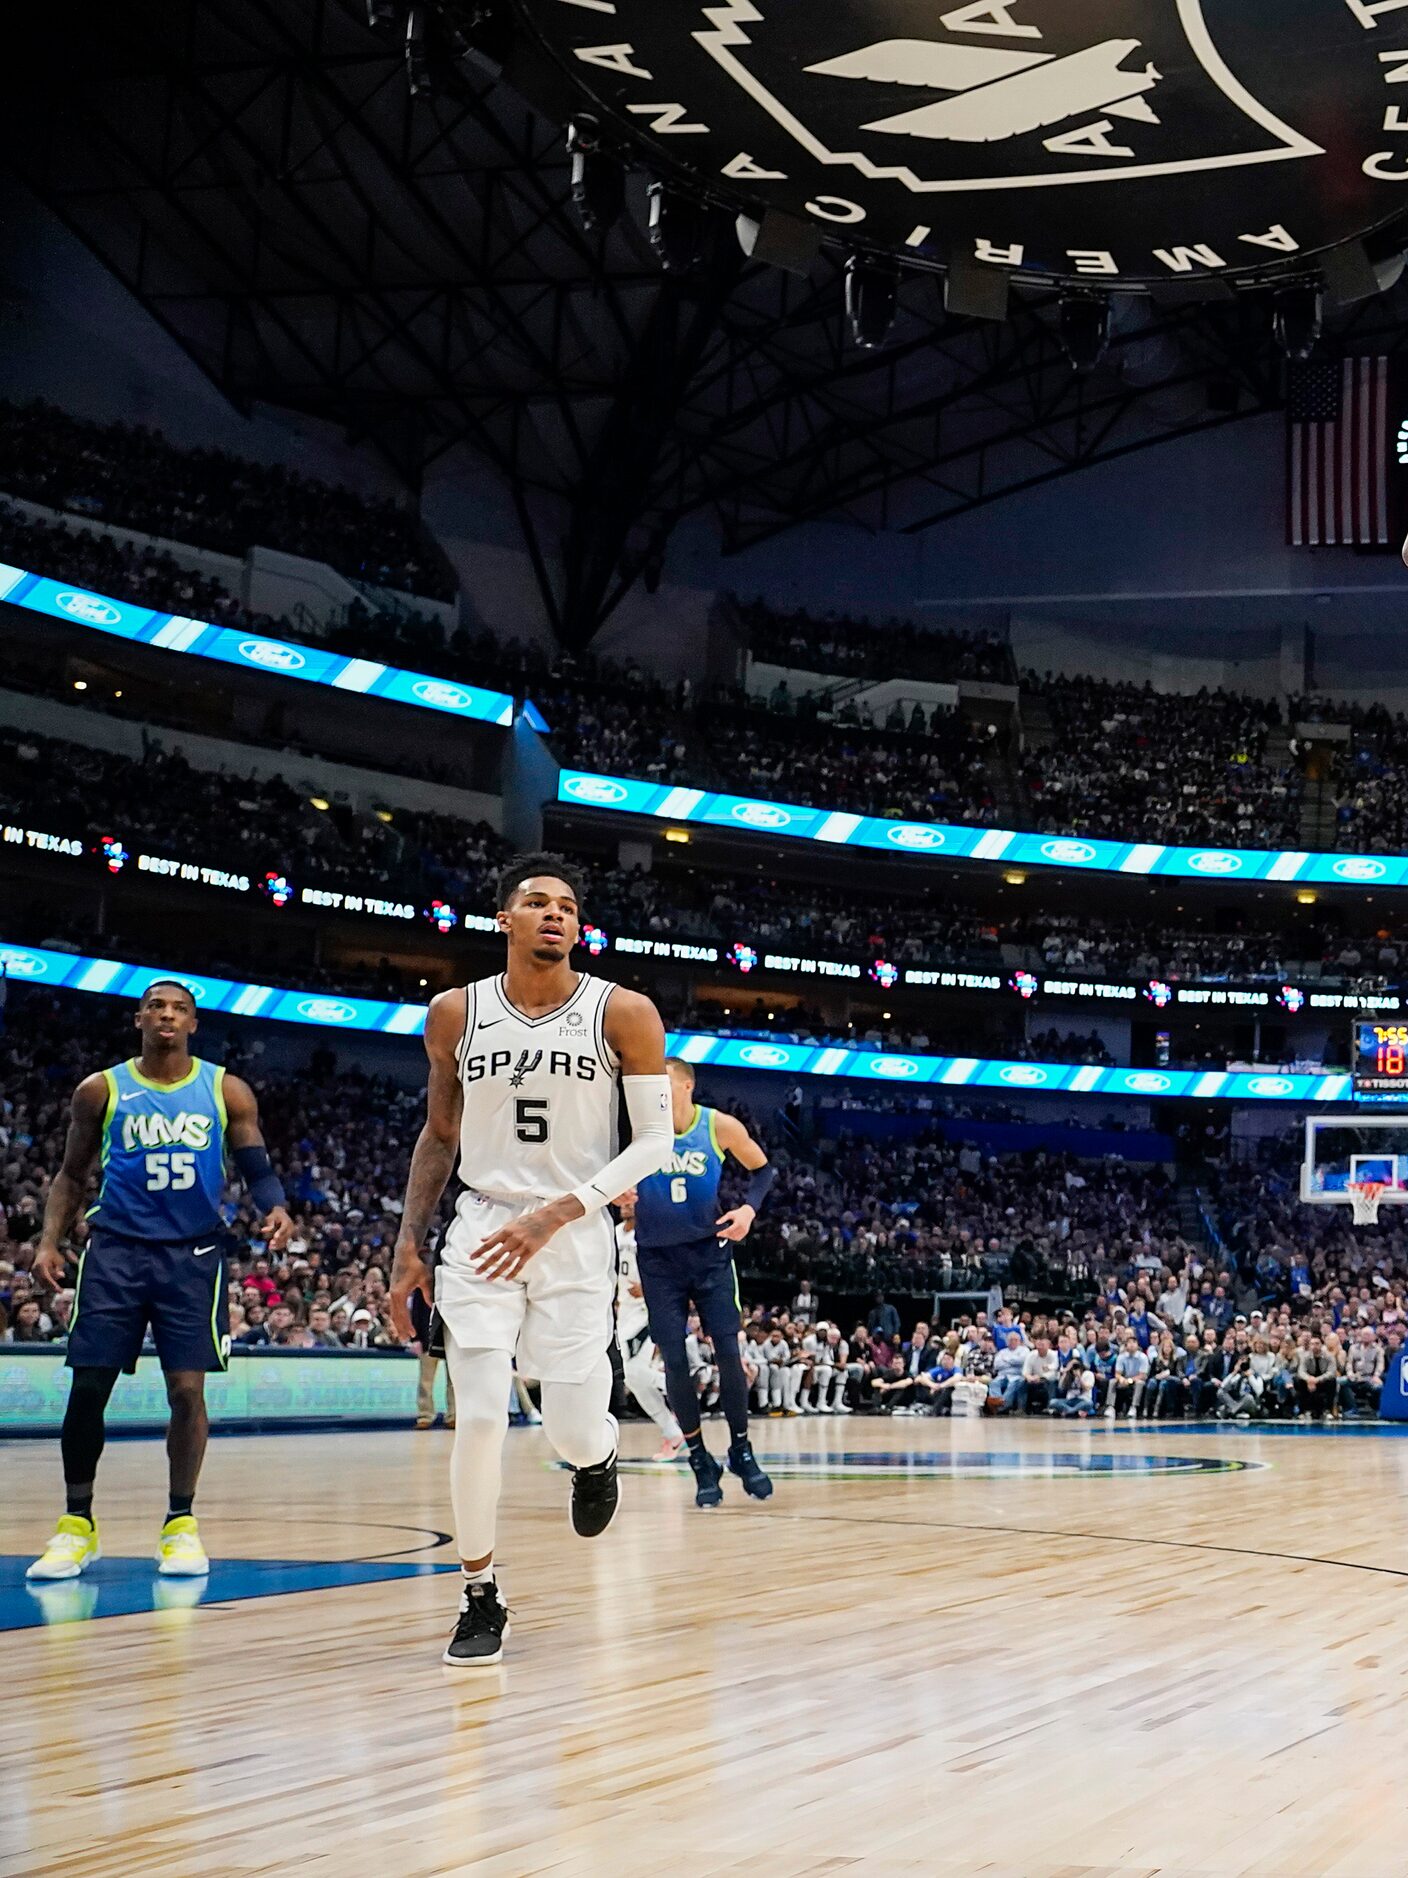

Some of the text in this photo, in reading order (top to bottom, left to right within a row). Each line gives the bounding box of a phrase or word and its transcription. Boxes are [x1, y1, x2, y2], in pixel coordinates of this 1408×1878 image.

[5, 827, 82, 855] IN TEXAS
[139, 855, 249, 890] BEST IN TEXAS
[302, 889, 414, 918] BEST IN TEXAS
[616, 938, 717, 961] BEST IN TEXAS
[765, 955, 860, 977] BEST IN TEXAS
[906, 971, 1000, 988] BEST IN TEXAS
[1044, 981, 1136, 998] BEST IN TEXAS
[1178, 990, 1268, 1004] BEST IN TEXAS
[1311, 995, 1342, 1007] BEST
[1344, 996, 1358, 1007] IN
[558, 1026, 588, 1037] Frost
[1373, 1026, 1408, 1046] 7:55
[467, 1049, 596, 1089] SPURS
[1376, 1045, 1404, 1074] 18
[123, 1111, 213, 1151] MAVS
[514, 1096, 550, 1145] 5
[145, 1152, 196, 1191] 55
[658, 1150, 708, 1177] AVS
[670, 1177, 688, 1204] 6
